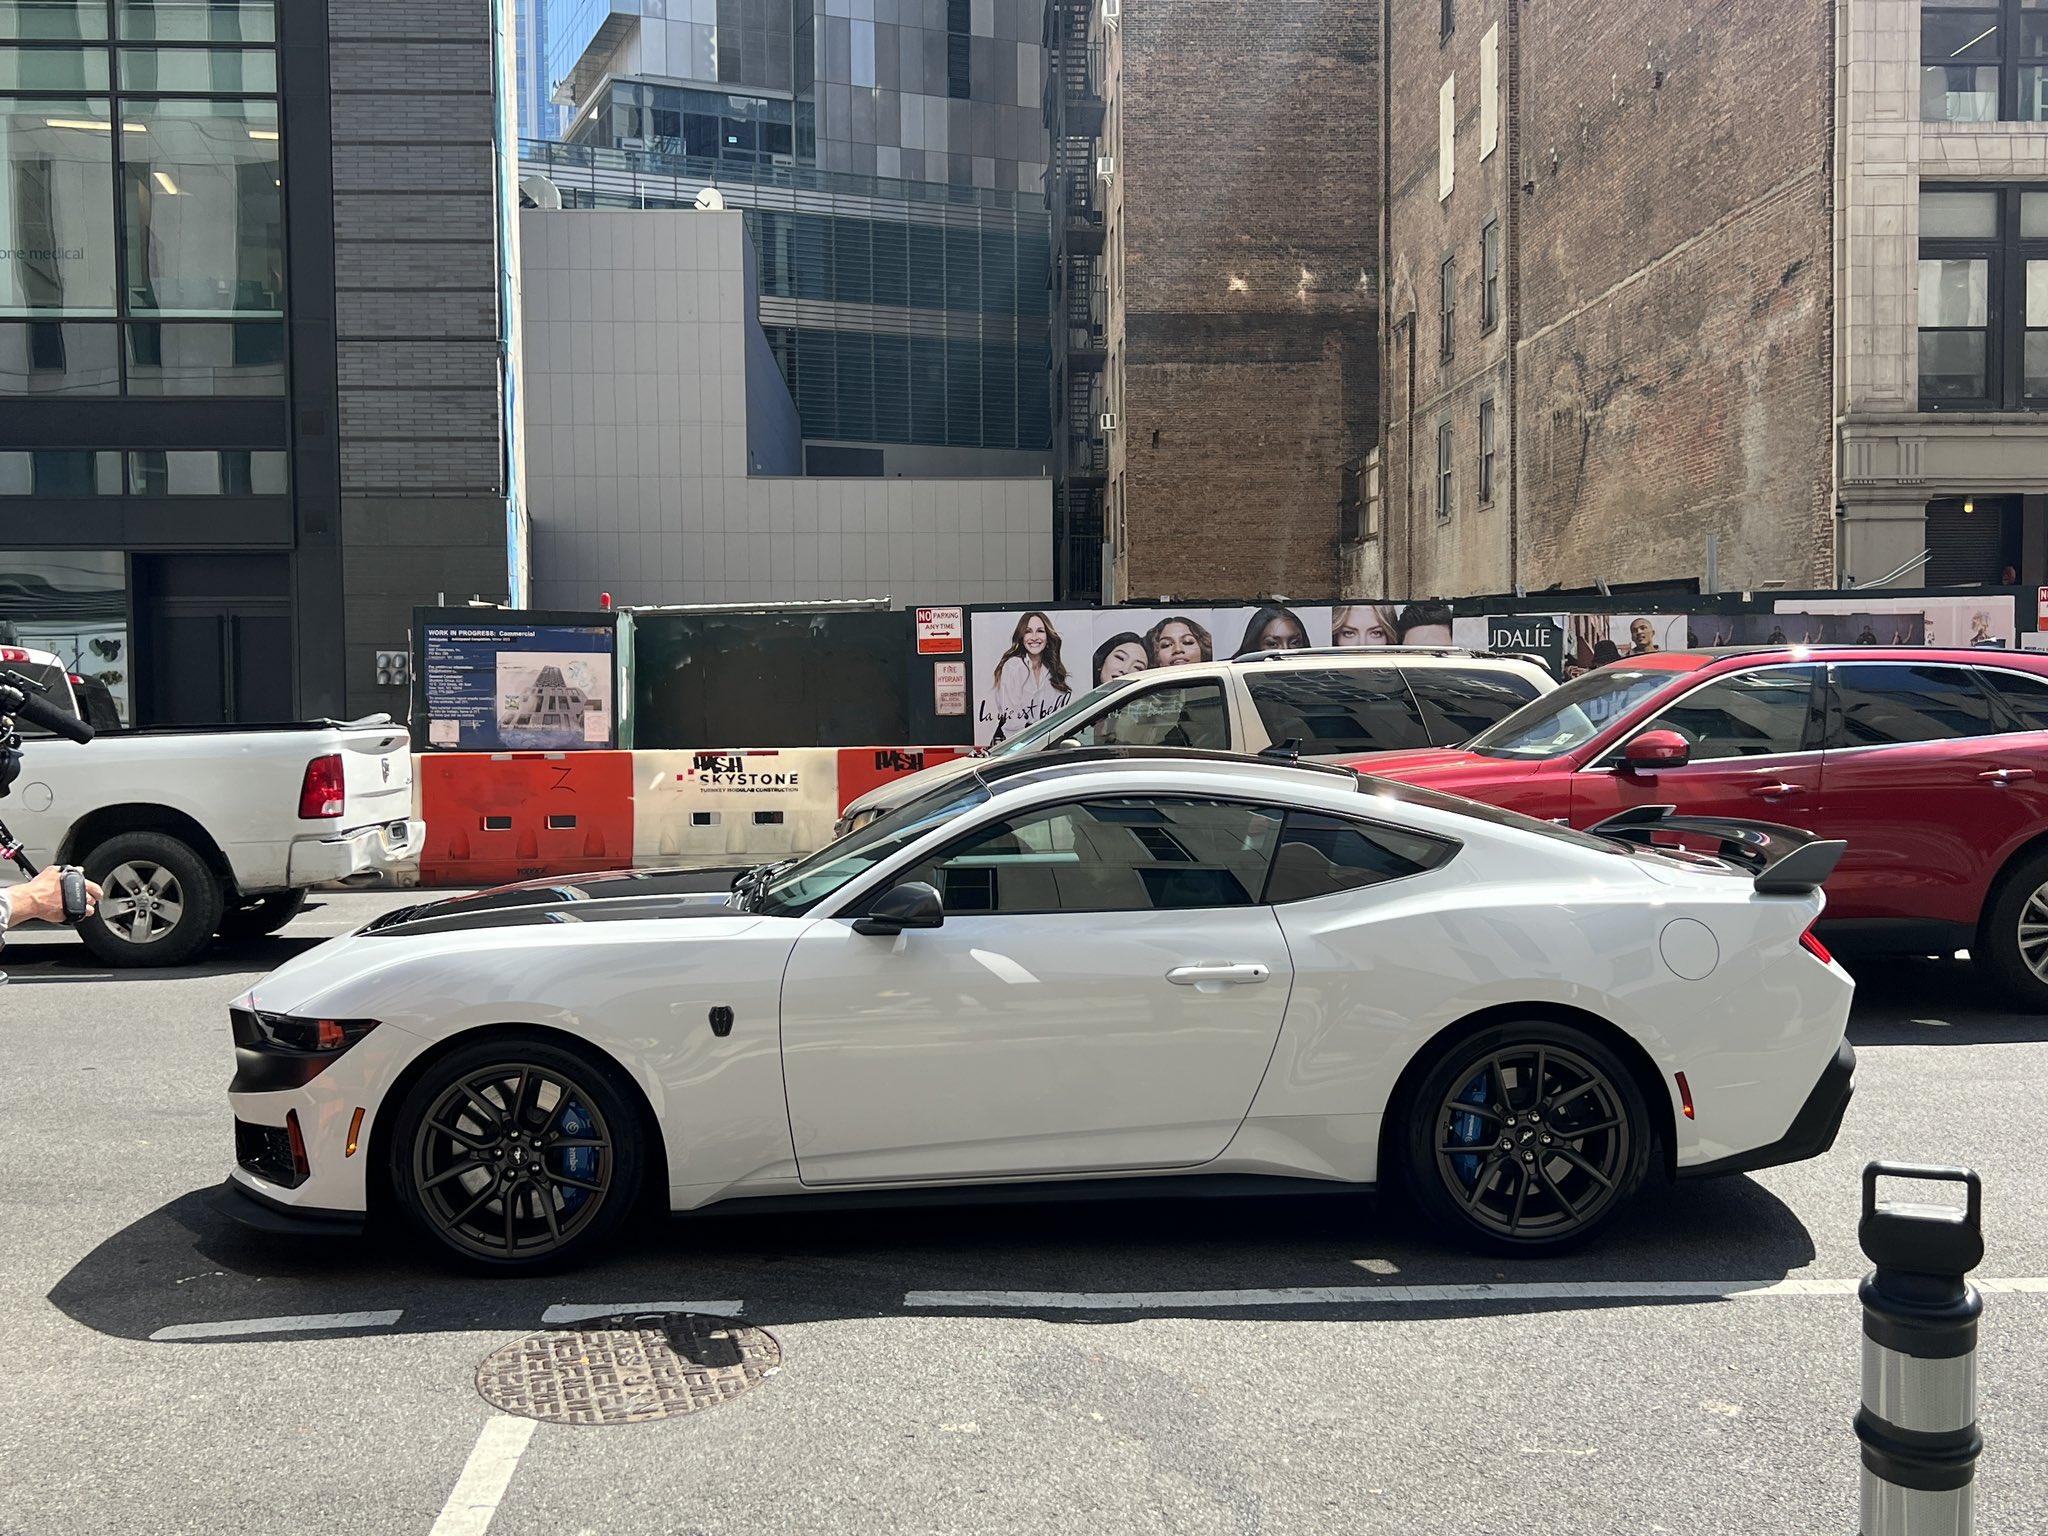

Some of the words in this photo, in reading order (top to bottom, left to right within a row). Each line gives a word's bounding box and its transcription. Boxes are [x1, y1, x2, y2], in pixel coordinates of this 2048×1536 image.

[0, 249, 25, 260] one
[29, 247, 84, 260] medical
[918, 611, 931, 622] NO
[458, 629, 496, 637] PROGRESS:
[937, 675, 963, 683] HYDRANT
[1039, 691, 1071, 720] bell
[700, 773, 799, 785] SKYSTONE
